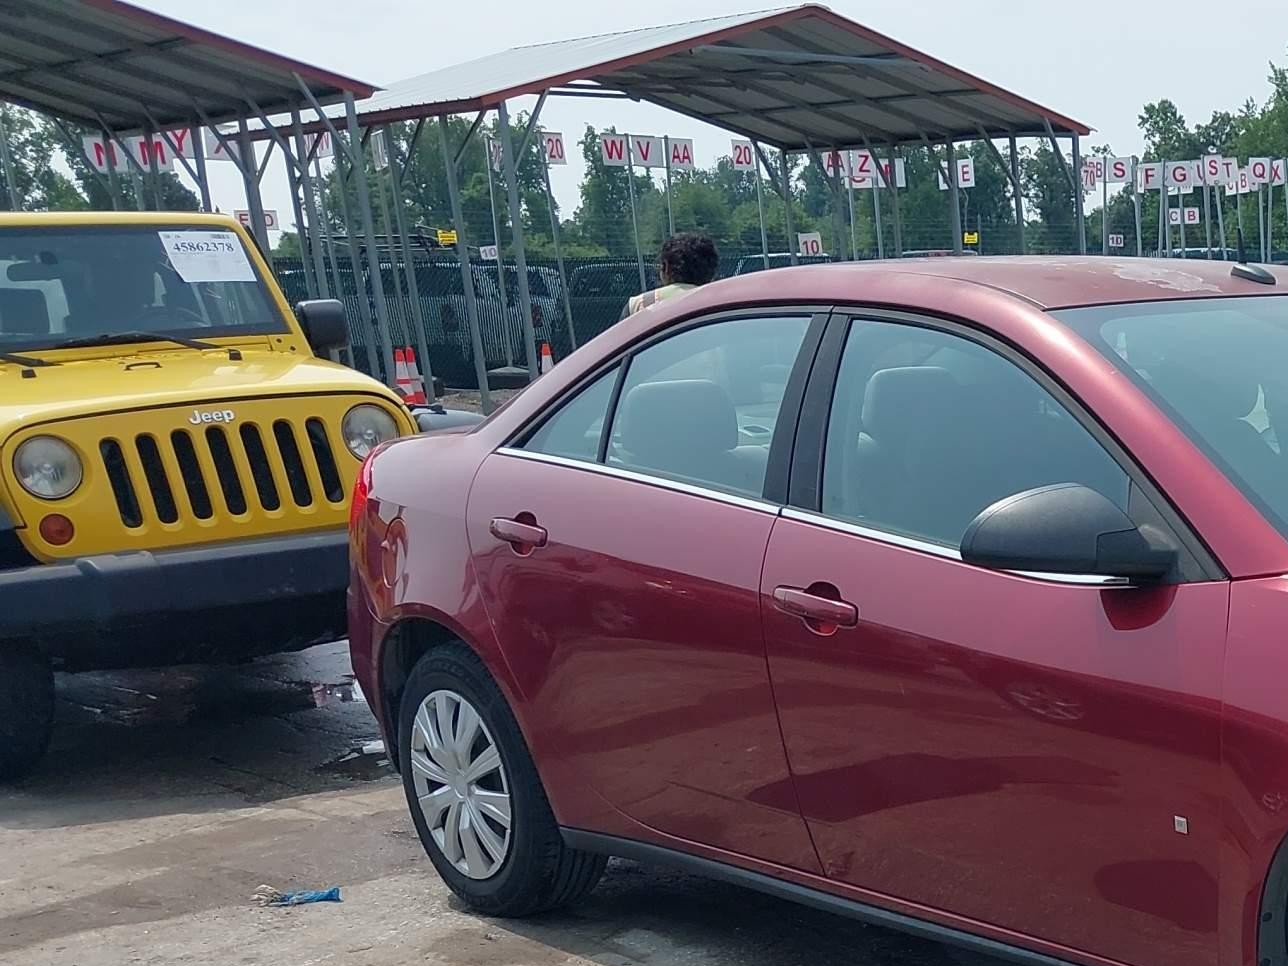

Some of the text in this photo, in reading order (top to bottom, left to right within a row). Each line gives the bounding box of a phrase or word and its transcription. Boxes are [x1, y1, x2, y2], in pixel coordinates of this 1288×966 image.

[171, 128, 188, 152] Y
[547, 138, 563, 159] 20
[603, 140, 623, 160] W
[637, 141, 650, 161] V
[672, 143, 691, 164] AA
[735, 144, 751, 165] 20
[858, 154, 871, 172] Z
[1113, 162, 1125, 178] S
[1209, 160, 1218, 175] S
[1222, 163, 1232, 178] T
[1253, 162, 1265, 179] Q
[962, 165, 970, 182] E
[1083, 169, 1095, 186] 70
[1145, 168, 1155, 184] F
[1172, 166, 1187, 182] G
[1240, 173, 1247, 188] B
[1272, 165, 1281, 182] X
[1169, 211, 1178, 221] C
[1187, 210, 1196, 221] B
[173, 242, 234, 252] 45862378
[482, 248, 497, 258] 10
[803, 239, 819, 255] 10
[189, 410, 235, 424] Jeep
